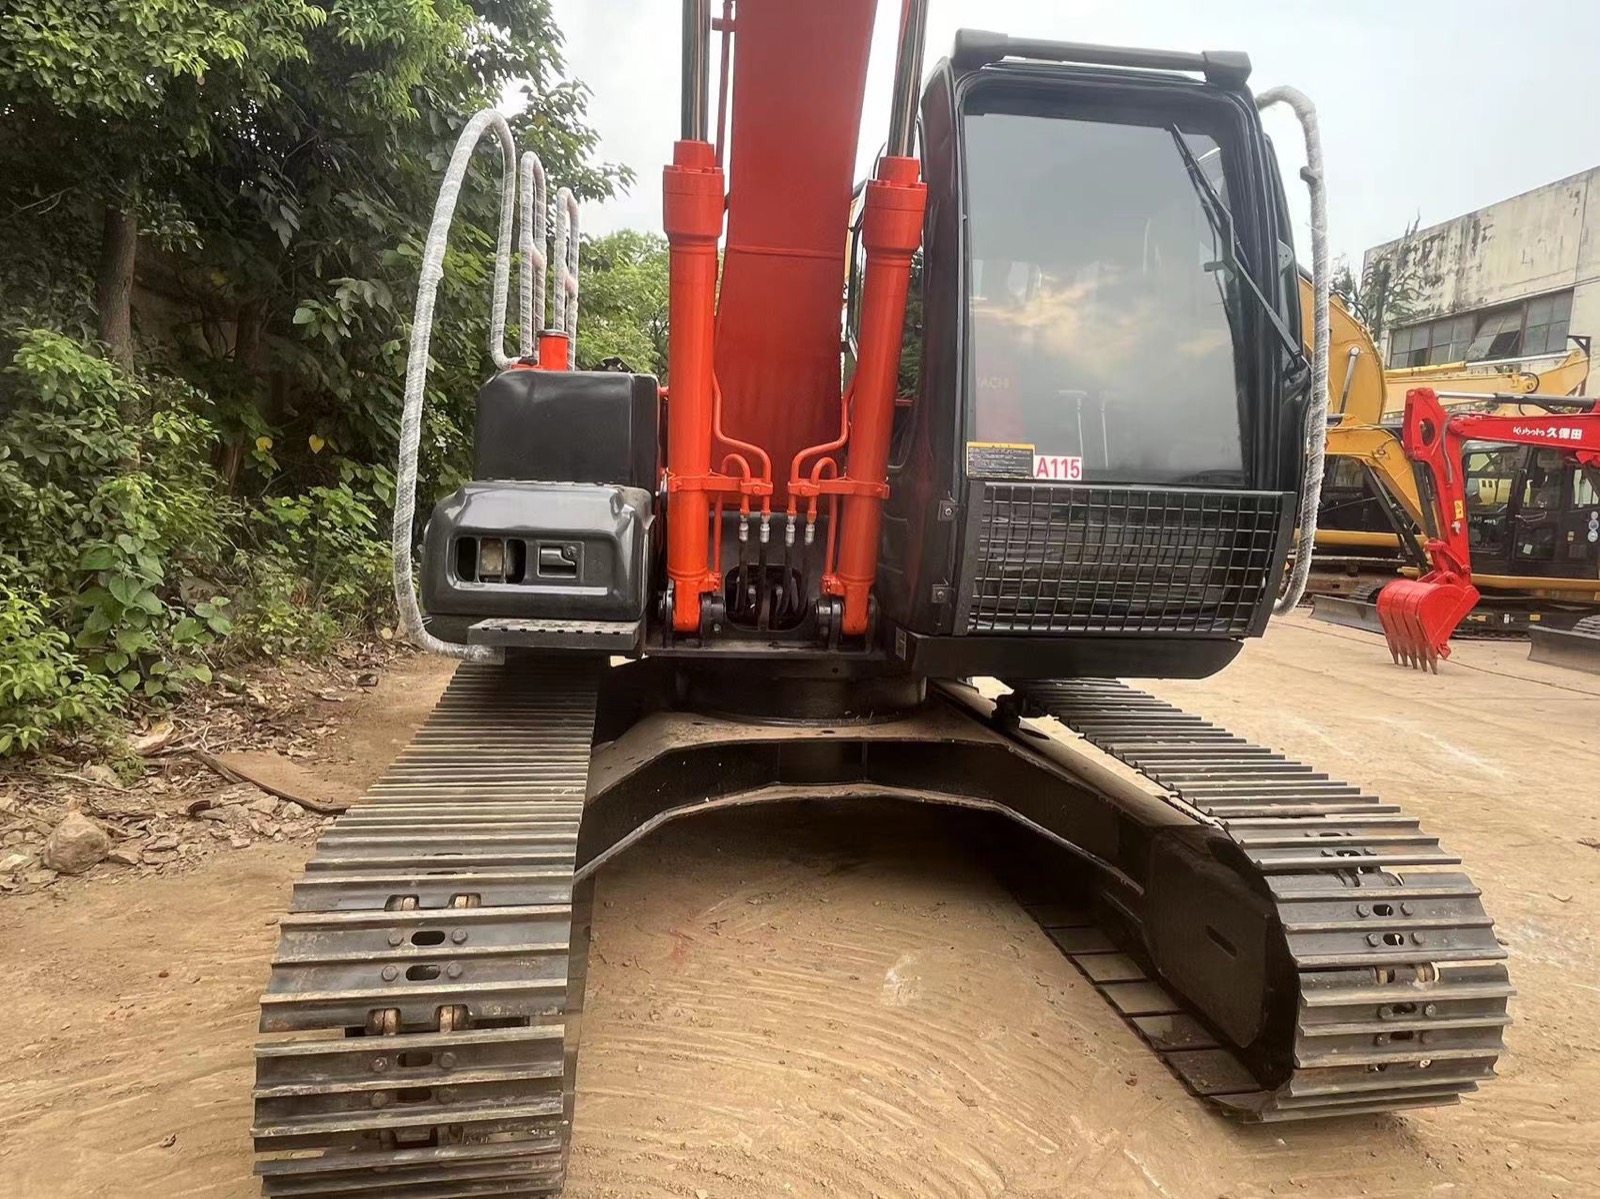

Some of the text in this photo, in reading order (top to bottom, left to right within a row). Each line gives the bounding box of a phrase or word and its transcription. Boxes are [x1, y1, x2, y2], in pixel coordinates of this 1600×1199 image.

[1512, 426, 1583, 440] Kubota 久保田
[1036, 456, 1080, 479] A115
